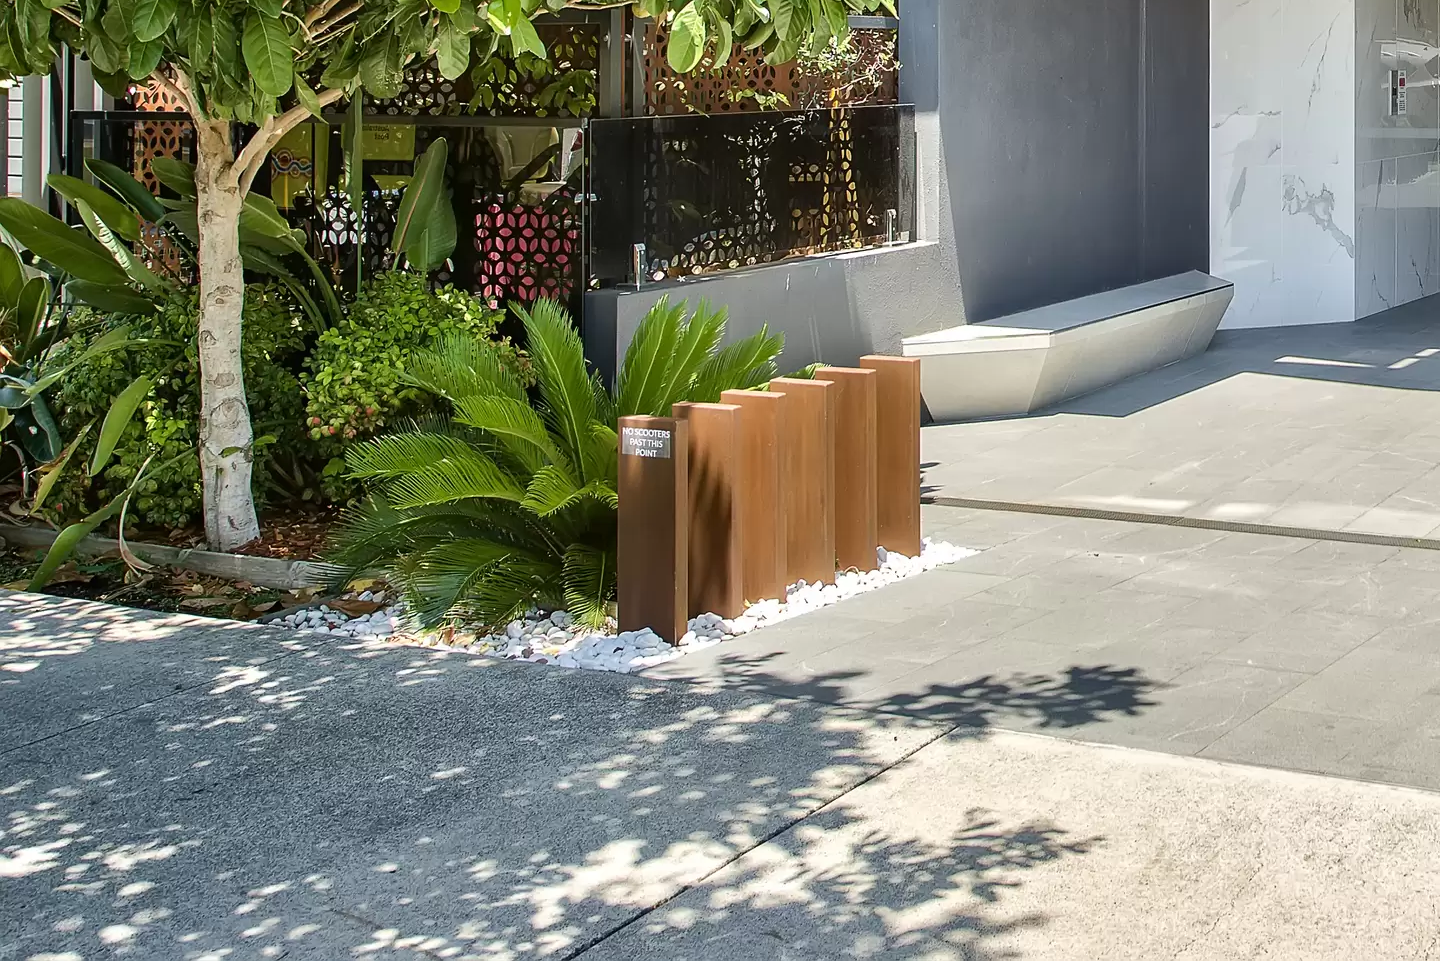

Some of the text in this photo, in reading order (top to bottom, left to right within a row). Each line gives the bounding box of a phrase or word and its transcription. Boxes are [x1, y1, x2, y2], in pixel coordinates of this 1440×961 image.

[622, 427, 671, 439] NO SCOOTERS
[629, 438, 663, 448] PAST THIS
[635, 448, 657, 458] POINT
